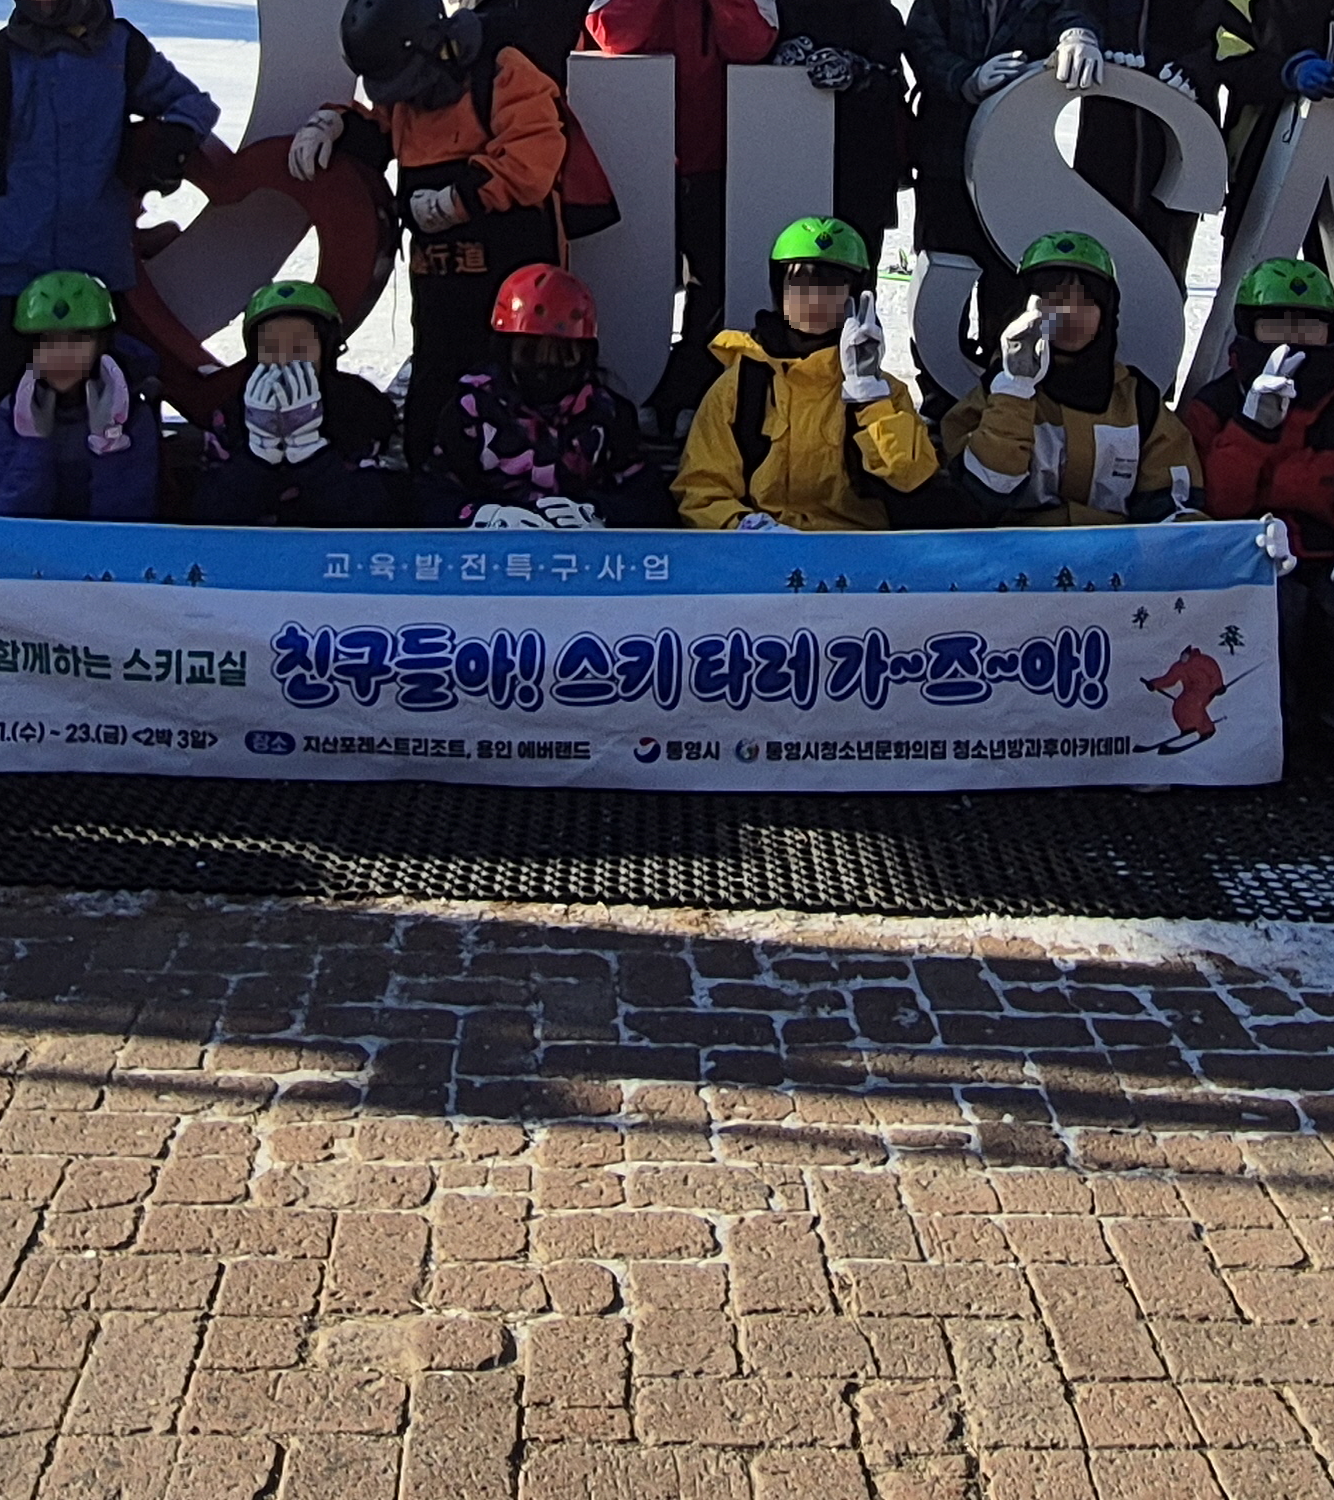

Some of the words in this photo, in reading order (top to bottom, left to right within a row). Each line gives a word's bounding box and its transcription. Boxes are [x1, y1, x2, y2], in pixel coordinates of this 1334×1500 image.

[122, 647, 248, 687] 스키교실
[270, 620, 546, 713] 친구들아!
[550, 625, 685, 712] 스키
[687, 625, 821, 711] 타러
[65, 723, 128, 746] 23.(금)
[131, 726, 173, 748] <2박
[176, 728, 219, 750] 3일>
[251, 732, 290, 753] 장소
[301, 734, 473, 760] 지산포레스트리조트,
[476, 739, 513, 760] 용인
[517, 739, 592, 761] 에버랜드
[665, 739, 721, 761] 통영시
[952, 735, 1131, 760] 청소년방과후아카데미
